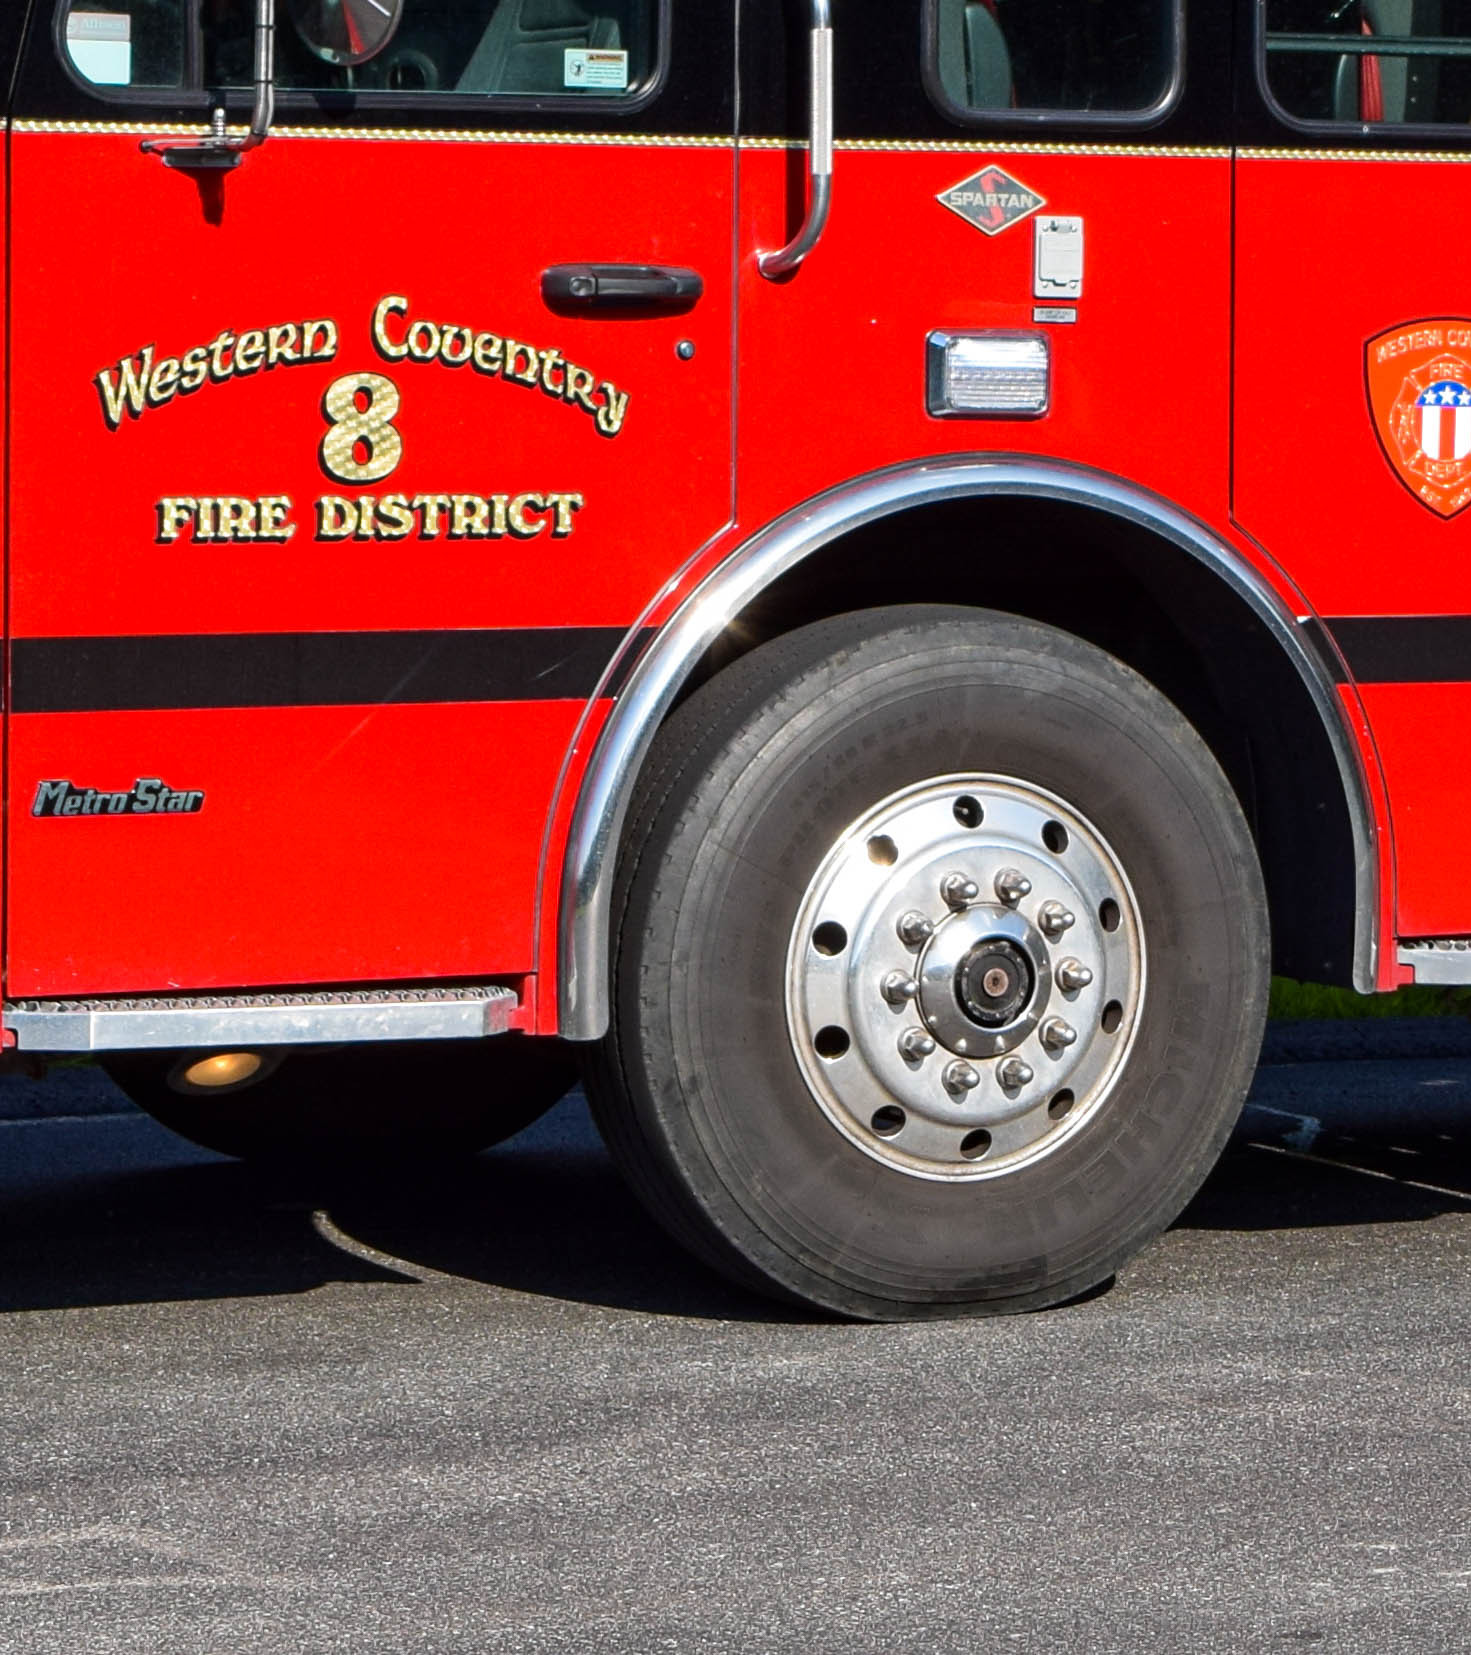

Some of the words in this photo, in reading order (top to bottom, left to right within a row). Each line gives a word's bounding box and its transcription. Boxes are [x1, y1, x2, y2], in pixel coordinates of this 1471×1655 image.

[950, 191, 1034, 209] SPARTAN
[94, 318, 337, 431] Western
[371, 294, 629, 438] Coventry
[1375, 328, 1443, 364] WESTERN
[1429, 362, 1464, 379] FIRE
[319, 371, 403, 484] 8
[155, 494, 296, 544] FIRE
[315, 493, 584, 542] DISTRICT
